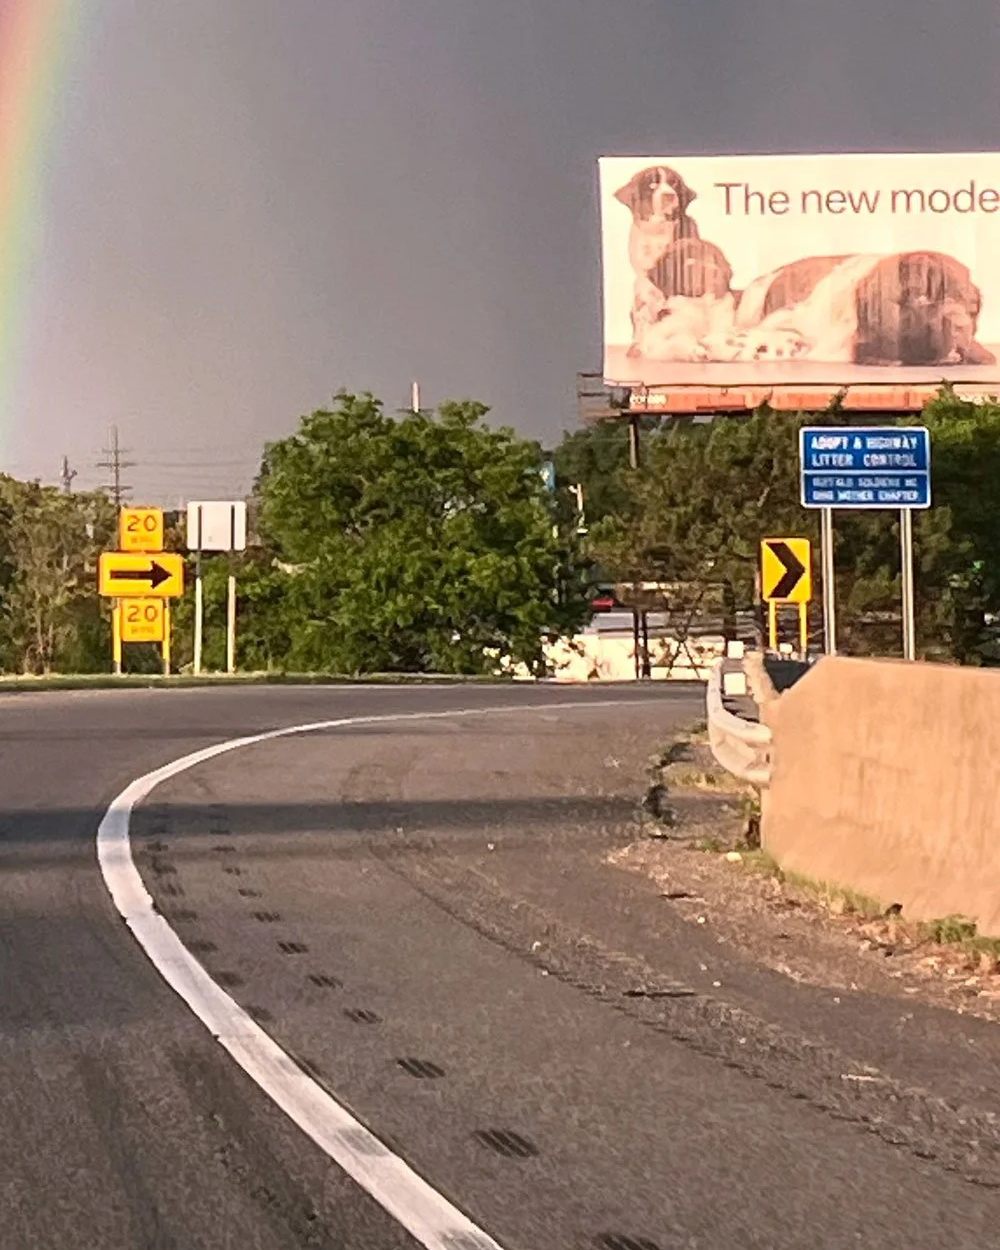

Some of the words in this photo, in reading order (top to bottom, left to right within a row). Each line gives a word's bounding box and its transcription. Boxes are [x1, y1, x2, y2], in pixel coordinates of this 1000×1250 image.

[714, 182, 790, 215] The
[801, 189, 881, 215] new
[811, 436, 849, 449] ADOPT
[853, 437, 862, 449] A
[865, 436, 917, 449] HIGHWAY
[811, 454, 854, 467] LITTER
[863, 454, 917, 467] CONTROL
[127, 515, 157, 532] 20
[127, 605, 158, 622] 20
